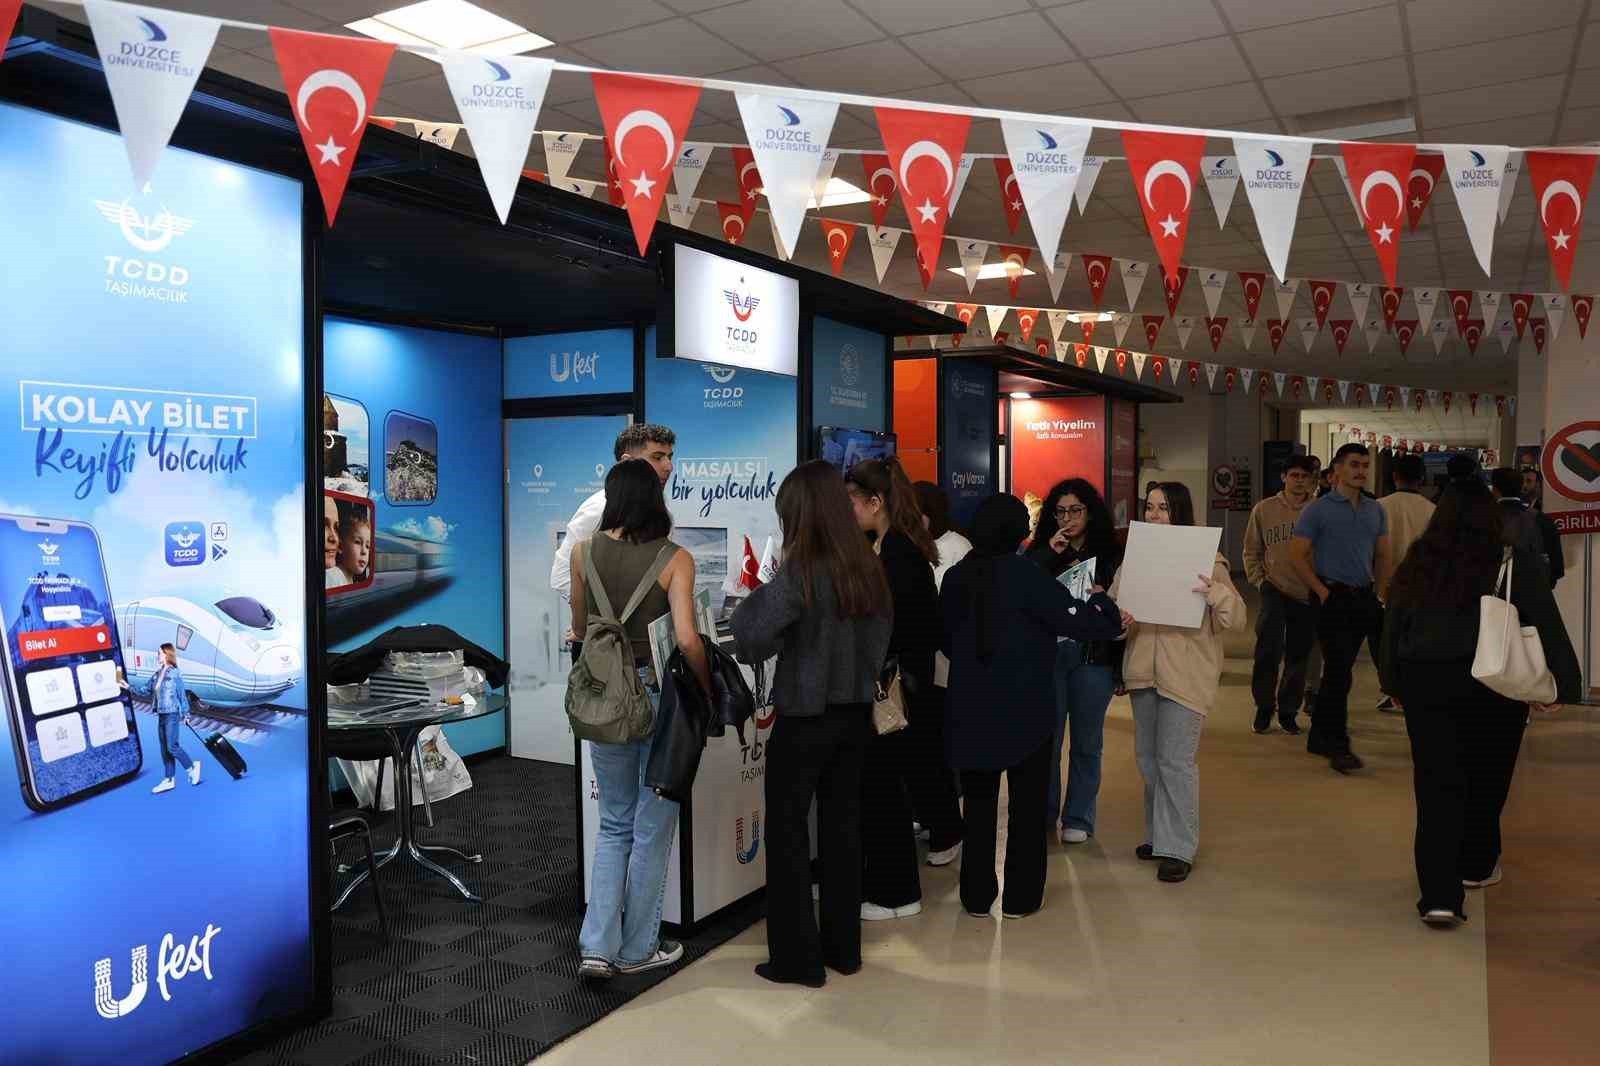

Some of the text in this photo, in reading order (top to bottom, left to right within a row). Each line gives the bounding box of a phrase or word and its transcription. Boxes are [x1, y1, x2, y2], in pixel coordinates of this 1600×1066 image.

[120, 42, 182, 63] DÜZCE
[472, 83, 524, 99] DÜZCE
[766, 128, 811, 143] DÜZCE
[1026, 152, 1068, 165] DÜZCE
[1256, 169, 1293, 180] DÜZCE
[1462, 168, 1495, 179] DÜZCE
[104, 255, 190, 286] TCDD
[104, 278, 189, 304] TAŞIMACILIK
[727, 326, 757, 343] TCDD
[573, 350, 600, 383] fest
[703, 387, 743, 399] TCDD
[32, 394, 249, 430] KOLAY BİLET
[1052, 419, 1096, 432] Yiyelim
[35, 427, 248, 500] Keyifli Yolculuk
[682, 462, 761, 477] MASALSI
[952, 471, 985, 488] Çay Varsa
[672, 472, 776, 517] bir yolculuk
[173, 549, 198, 557] TCDD
[25, 638, 57, 650] Bilet Al
[157, 923, 222, 1001] fest
